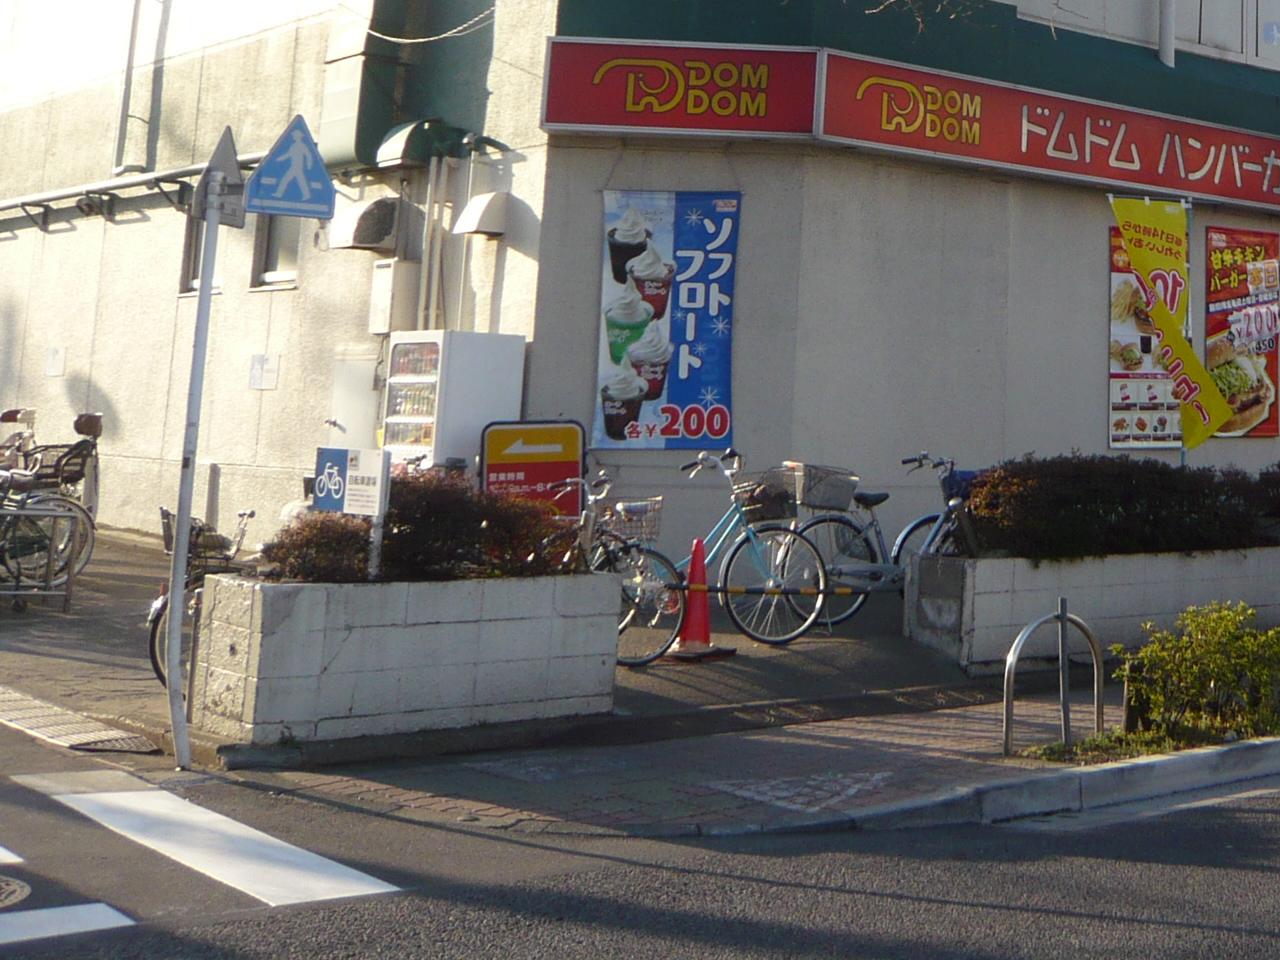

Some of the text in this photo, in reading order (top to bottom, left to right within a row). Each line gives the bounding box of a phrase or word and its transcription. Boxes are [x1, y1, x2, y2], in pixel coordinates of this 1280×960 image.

[684, 60, 769, 90] DOM
[686, 89, 768, 118] DOM
[923, 85, 982, 119] DOM
[925, 111, 981, 145] DOM
[1021, 103, 1141, 171] ドムドム
[703, 218, 733, 317] ソフト
[676, 250, 705, 379] フロート
